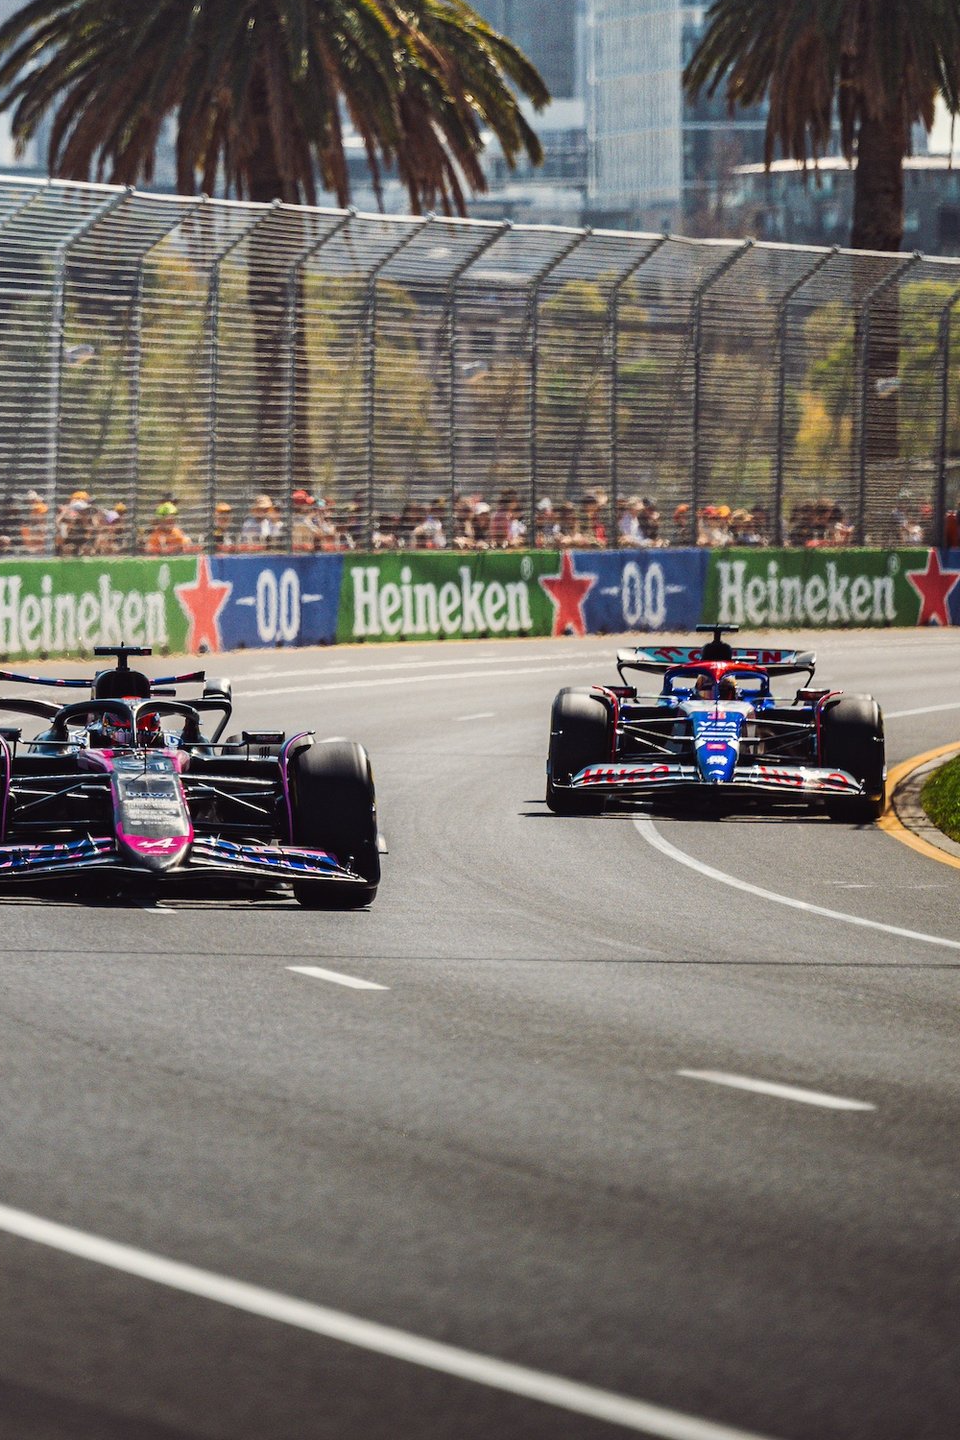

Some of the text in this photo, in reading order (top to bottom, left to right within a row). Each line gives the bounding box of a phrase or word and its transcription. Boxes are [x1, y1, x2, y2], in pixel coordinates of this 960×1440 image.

[256, 568, 301, 642] 0.0
[351, 565, 533, 636] Heineken
[621, 561, 667, 627] 0.0
[716, 560, 898, 627] Heineken
[582, 765, 671, 784] HUGO
